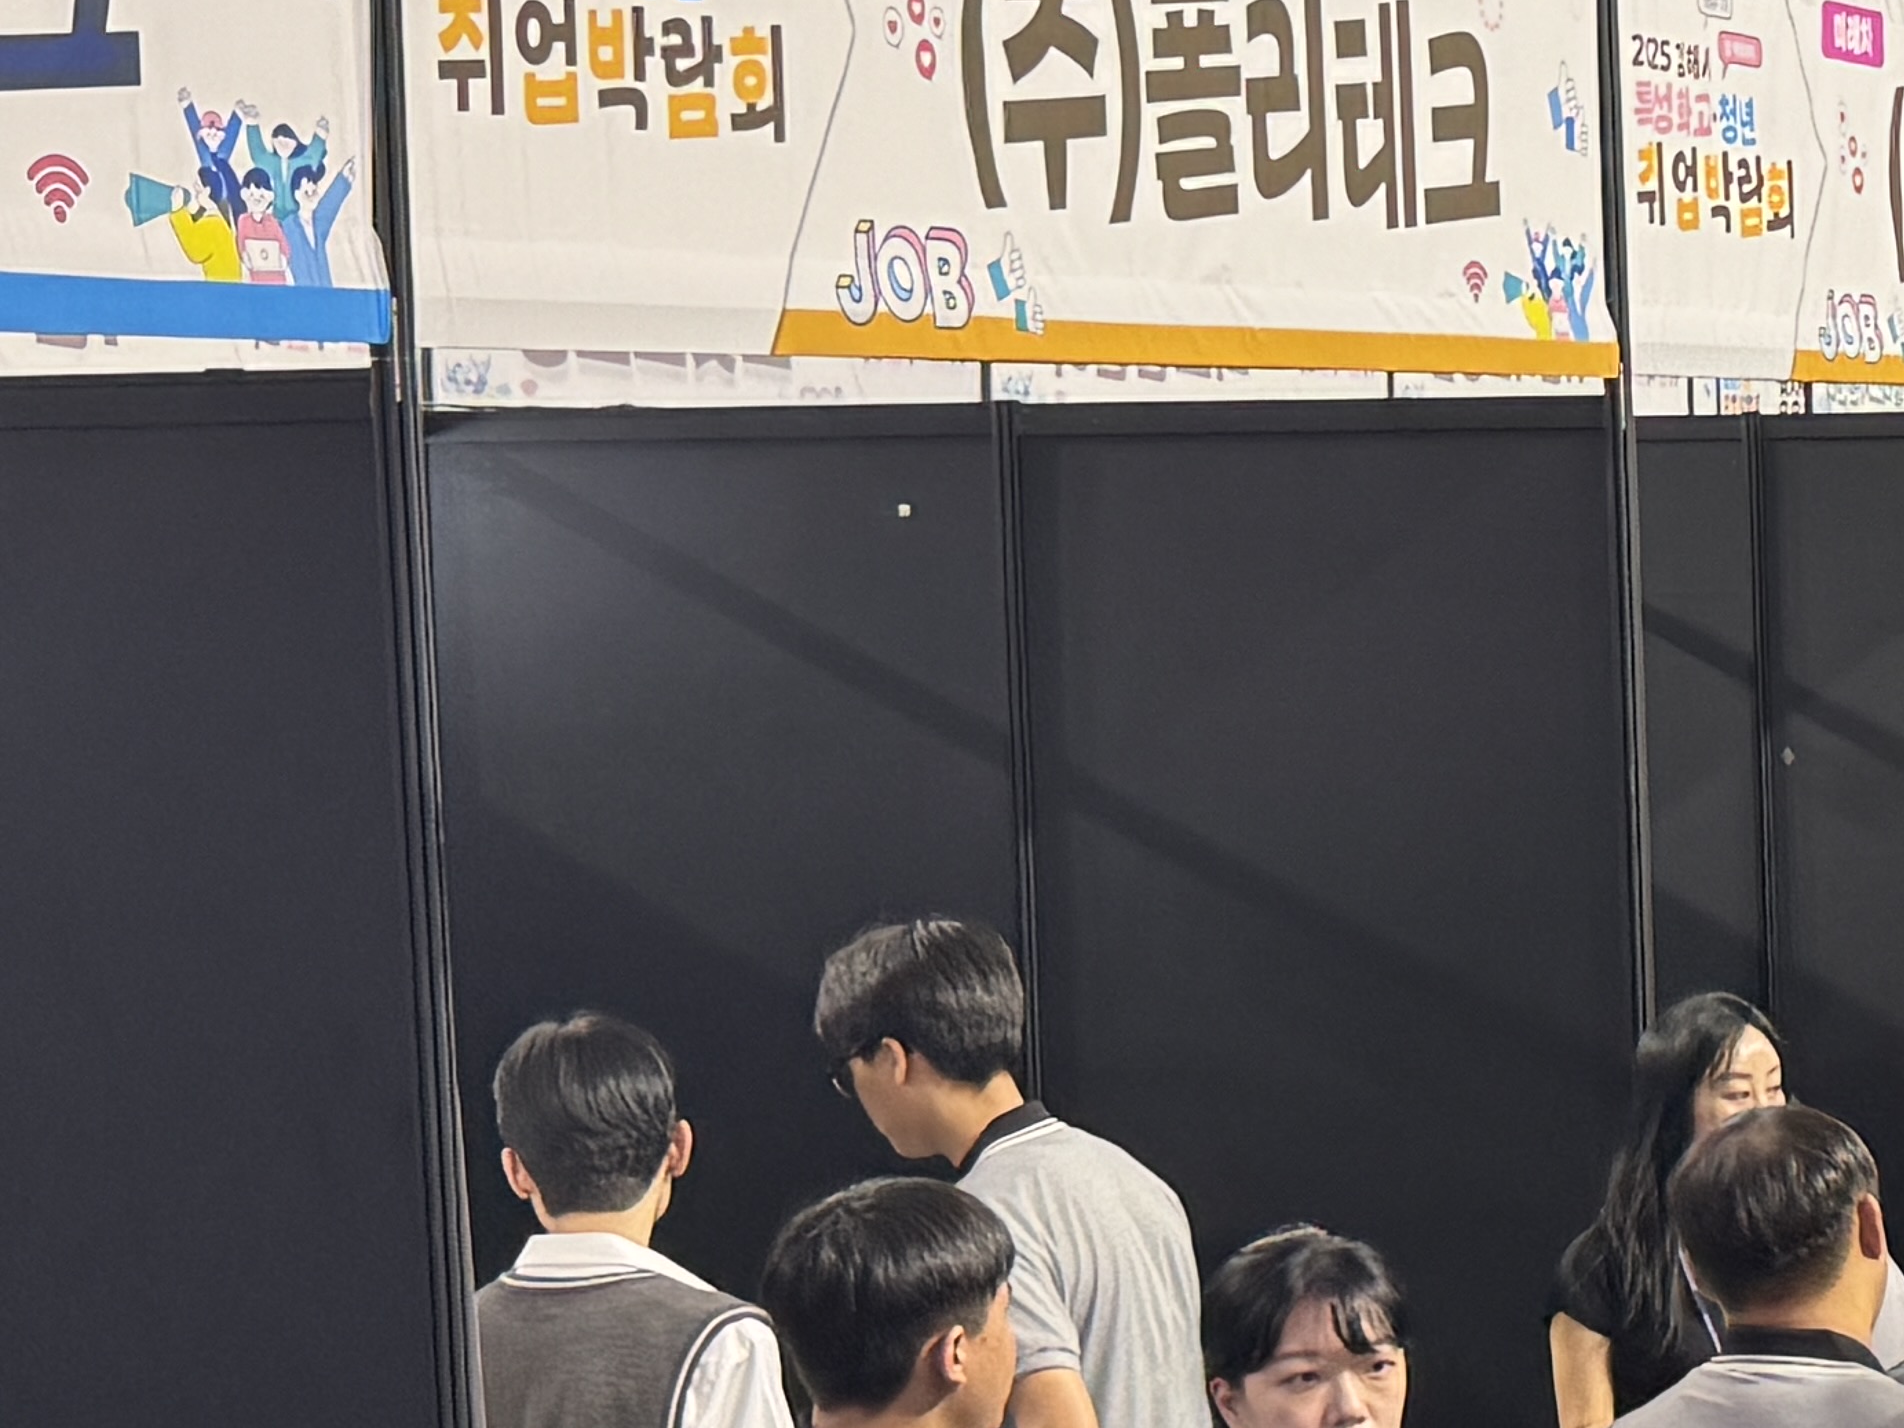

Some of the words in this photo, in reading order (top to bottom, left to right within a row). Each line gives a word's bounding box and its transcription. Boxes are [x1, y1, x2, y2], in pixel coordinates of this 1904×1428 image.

[1636, 141, 1796, 239] 취업박람회
[835, 218, 976, 329] JOB
[1819, 288, 1883, 364] JOB
